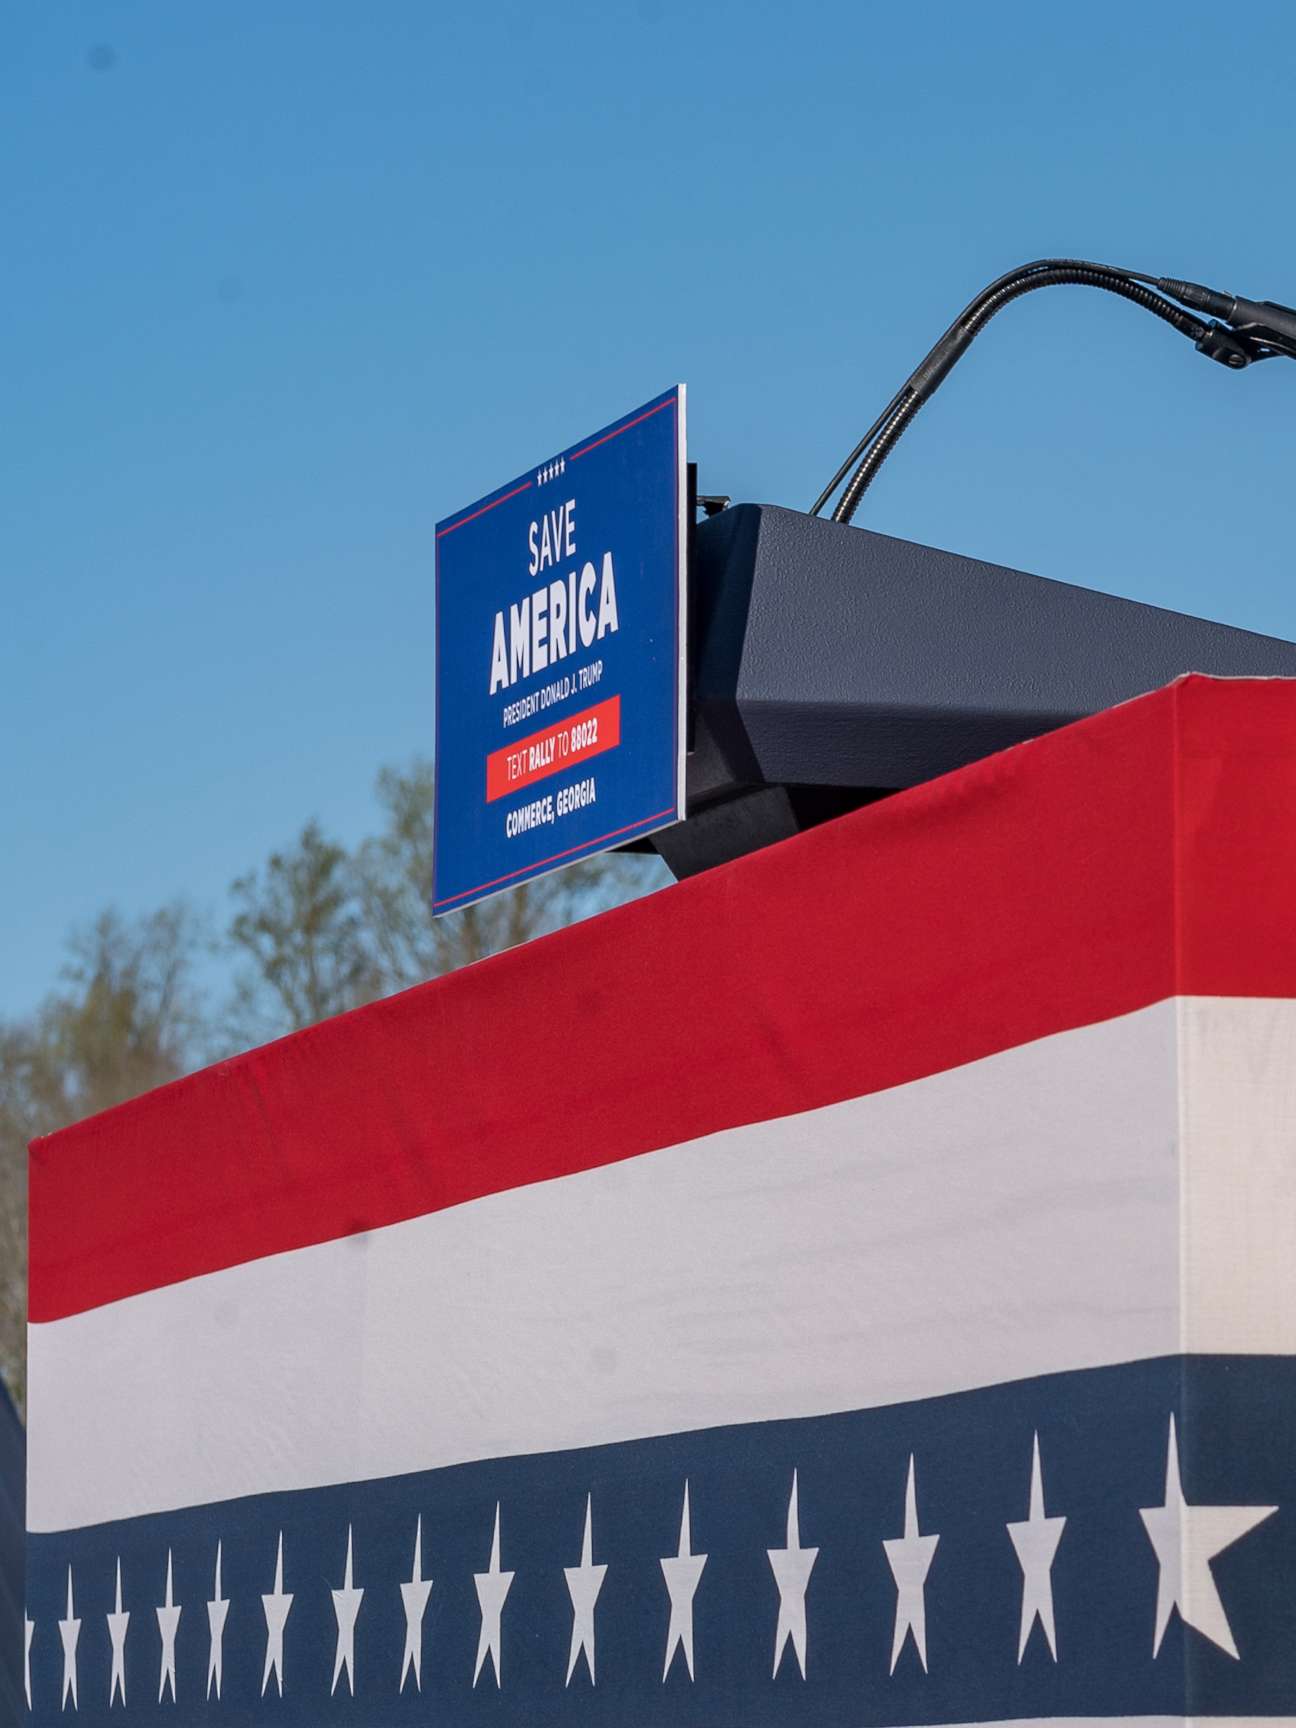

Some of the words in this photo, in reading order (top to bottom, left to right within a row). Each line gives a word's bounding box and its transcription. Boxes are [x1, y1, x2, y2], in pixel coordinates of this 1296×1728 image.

[528, 499, 576, 577] SAVE
[490, 551, 619, 695] AMERICA
[503, 692, 541, 729] PRESIDENT
[540, 676, 571, 710] DONALD
[570, 673, 578, 695] J.
[578, 659, 604, 691] TRUMP
[506, 748, 528, 781] TEXT
[528, 736, 557, 772] RALLY
[557, 731, 570, 760] TO
[570, 717, 598, 753] 88022
[506, 795, 556, 839] COMMERCE,
[556, 777, 597, 817] GEORGIA
